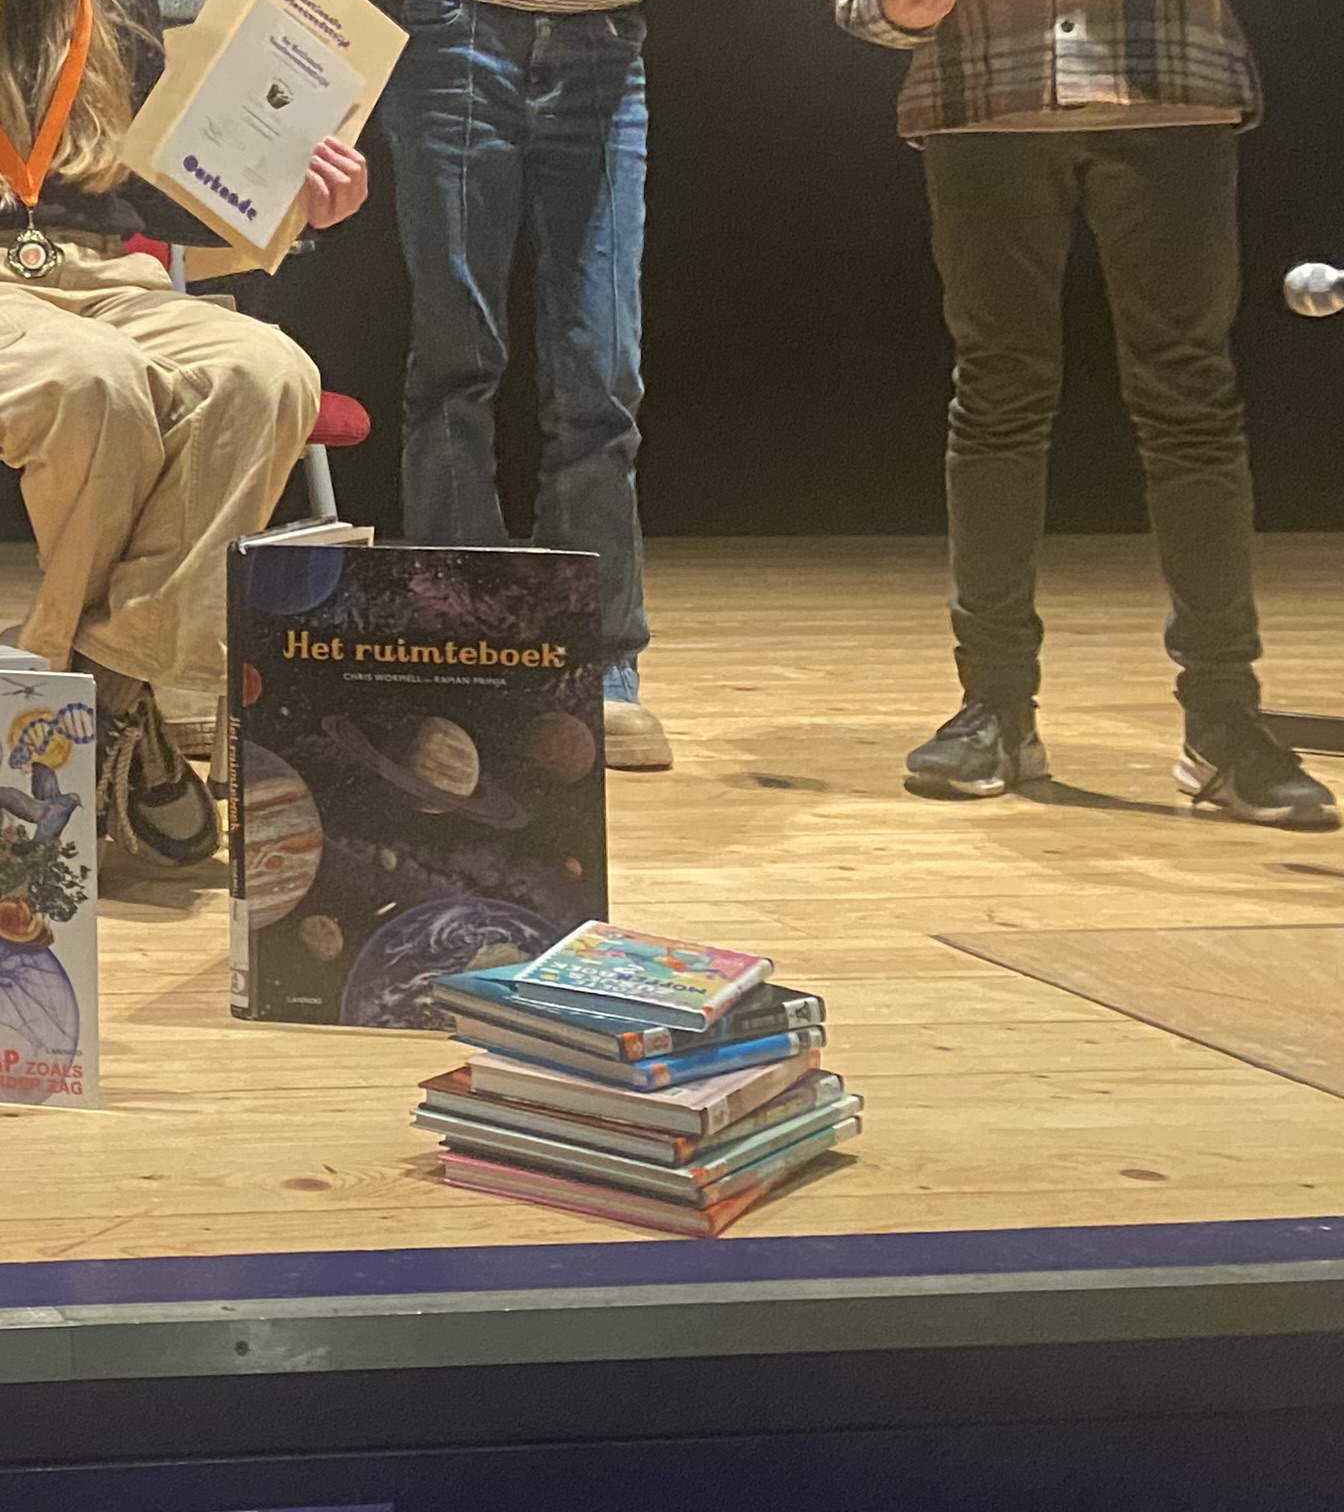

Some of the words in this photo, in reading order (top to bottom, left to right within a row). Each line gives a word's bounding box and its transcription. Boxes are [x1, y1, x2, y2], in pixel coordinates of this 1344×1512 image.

[182, 154, 258, 221] Oorkonde
[282, 630, 345, 661] Het
[353, 638, 566, 669] ruimteboek
[343, 672, 372, 682] CHRIS
[25, 1061, 84, 1078] ZOALS
[47, 1079, 84, 1096] ZAG
